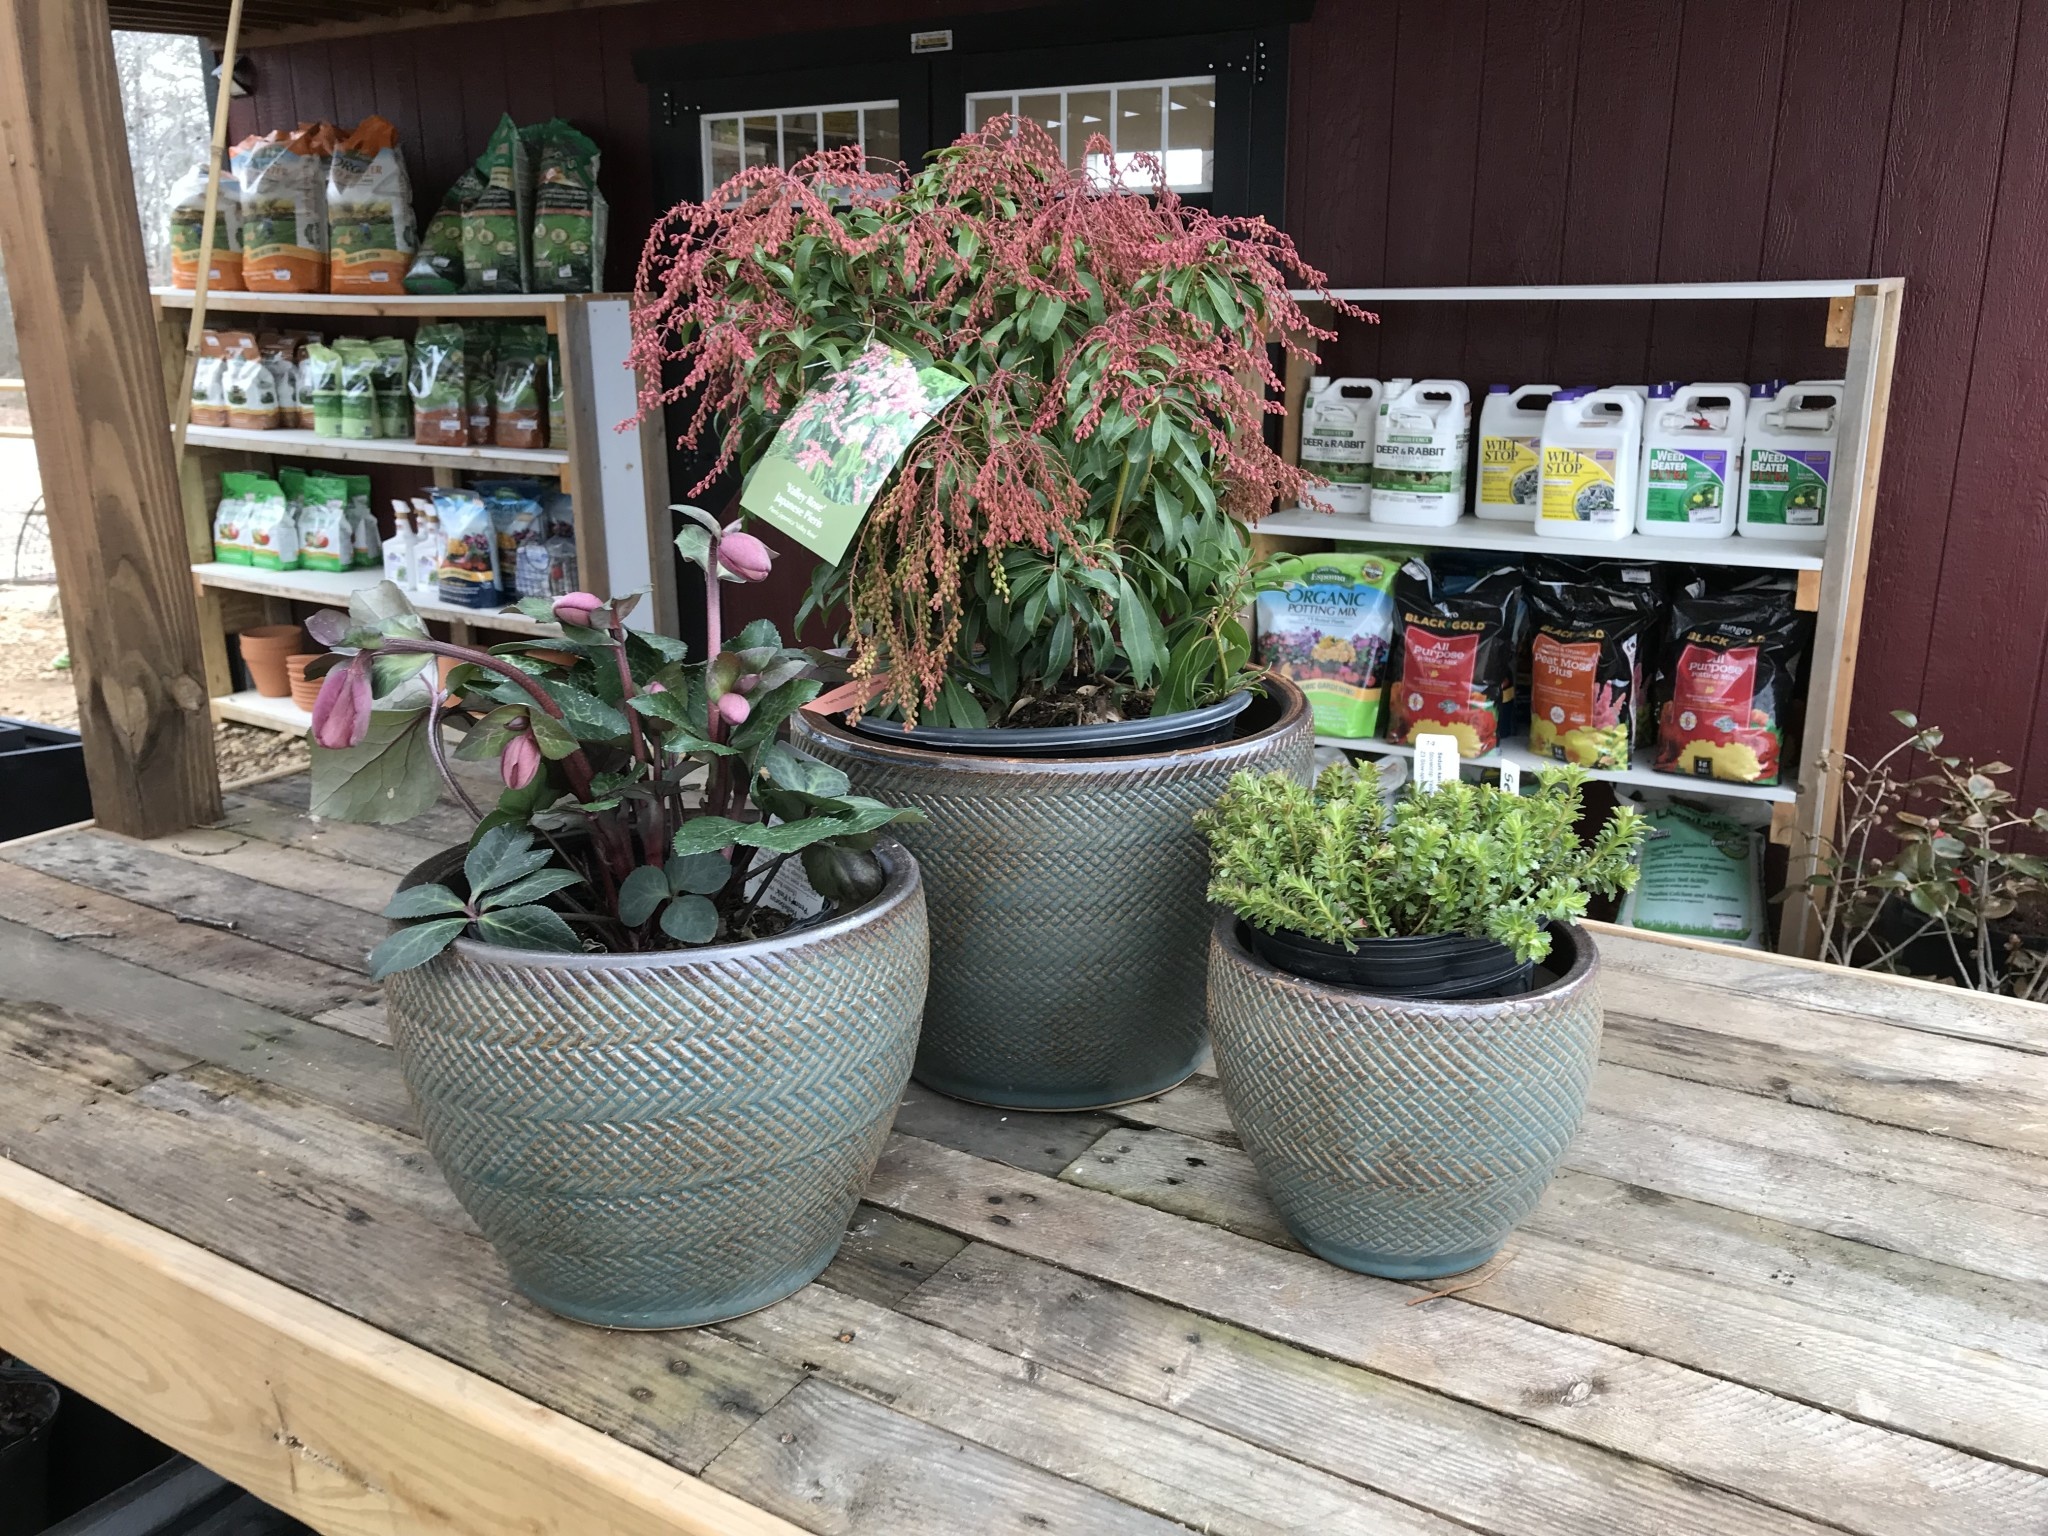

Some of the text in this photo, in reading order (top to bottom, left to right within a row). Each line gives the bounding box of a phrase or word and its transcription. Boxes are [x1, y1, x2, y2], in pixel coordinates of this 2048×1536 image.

[1303, 438, 1324, 448] DEER
[1330, 440, 1366, 450] RABBIT
[1376, 444, 1400, 454] DEER
[1407, 447, 1446, 456] RABBIT
[1485, 440, 1519, 450] WILT
[1485, 450, 1518, 460] STOP
[1548, 450, 1584, 462] WILT
[1656, 450, 1686, 462] WEED
[1758, 451, 1786, 462] WEED
[1546, 462, 1583, 474] STOP
[1650, 459, 1688, 472] BEATER
[1752, 460, 1789, 472] BEATER
[1650, 470, 1688, 480] ULTRA
[1750, 472, 1790, 482] ULTRA
[774, 492, 824, 528] Japanese Pieris
[1311, 572, 1346, 582] Espoma
[1286, 588, 1366, 606] ORGANIC
[1288, 604, 1358, 617] POTTING MIX
[1405, 612, 1486, 630] BLACK GOLD
[1720, 624, 1752, 636] sungro
[1686, 631, 1730, 646] BLACK
[1432, 642, 1450, 650] All
[1414, 645, 1465, 660] Purpose
[1534, 652, 1558, 666] Peat
[1560, 658, 1592, 672] Moss
[1548, 666, 1573, 678] Plus
[1688, 662, 1744, 675] Purpose
